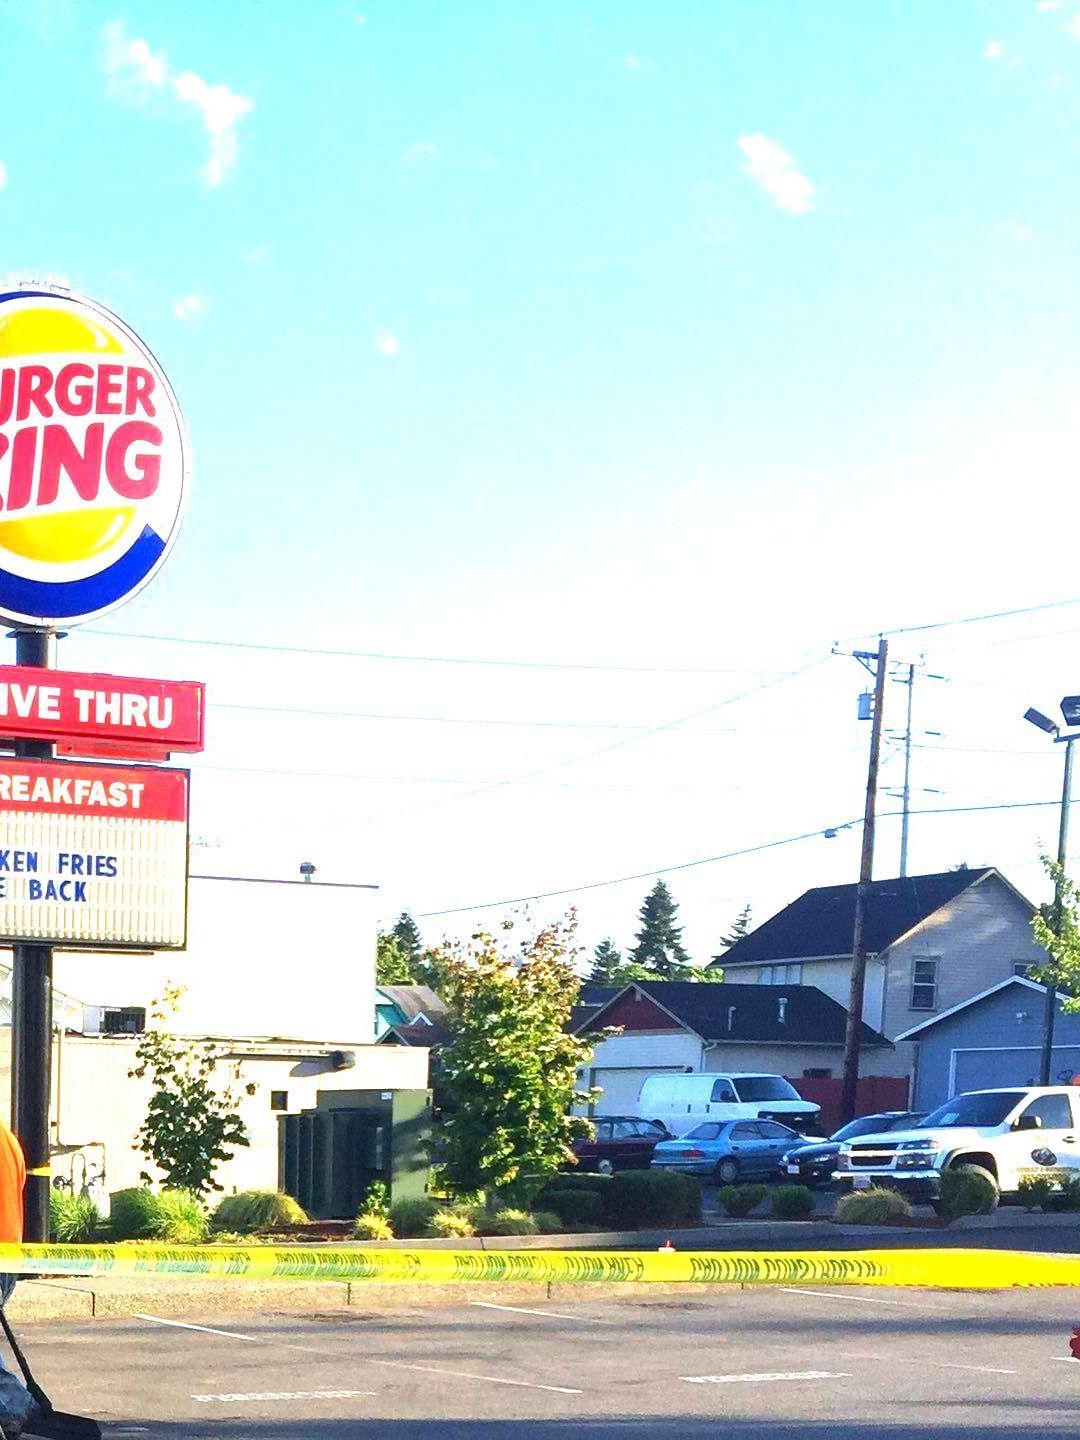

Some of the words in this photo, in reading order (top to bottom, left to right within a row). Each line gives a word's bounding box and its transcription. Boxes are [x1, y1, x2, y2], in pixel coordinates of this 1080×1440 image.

[73, 689, 174, 730] THRU
[57, 852, 119, 878] FRIES
[28, 879, 88, 903] BACK
